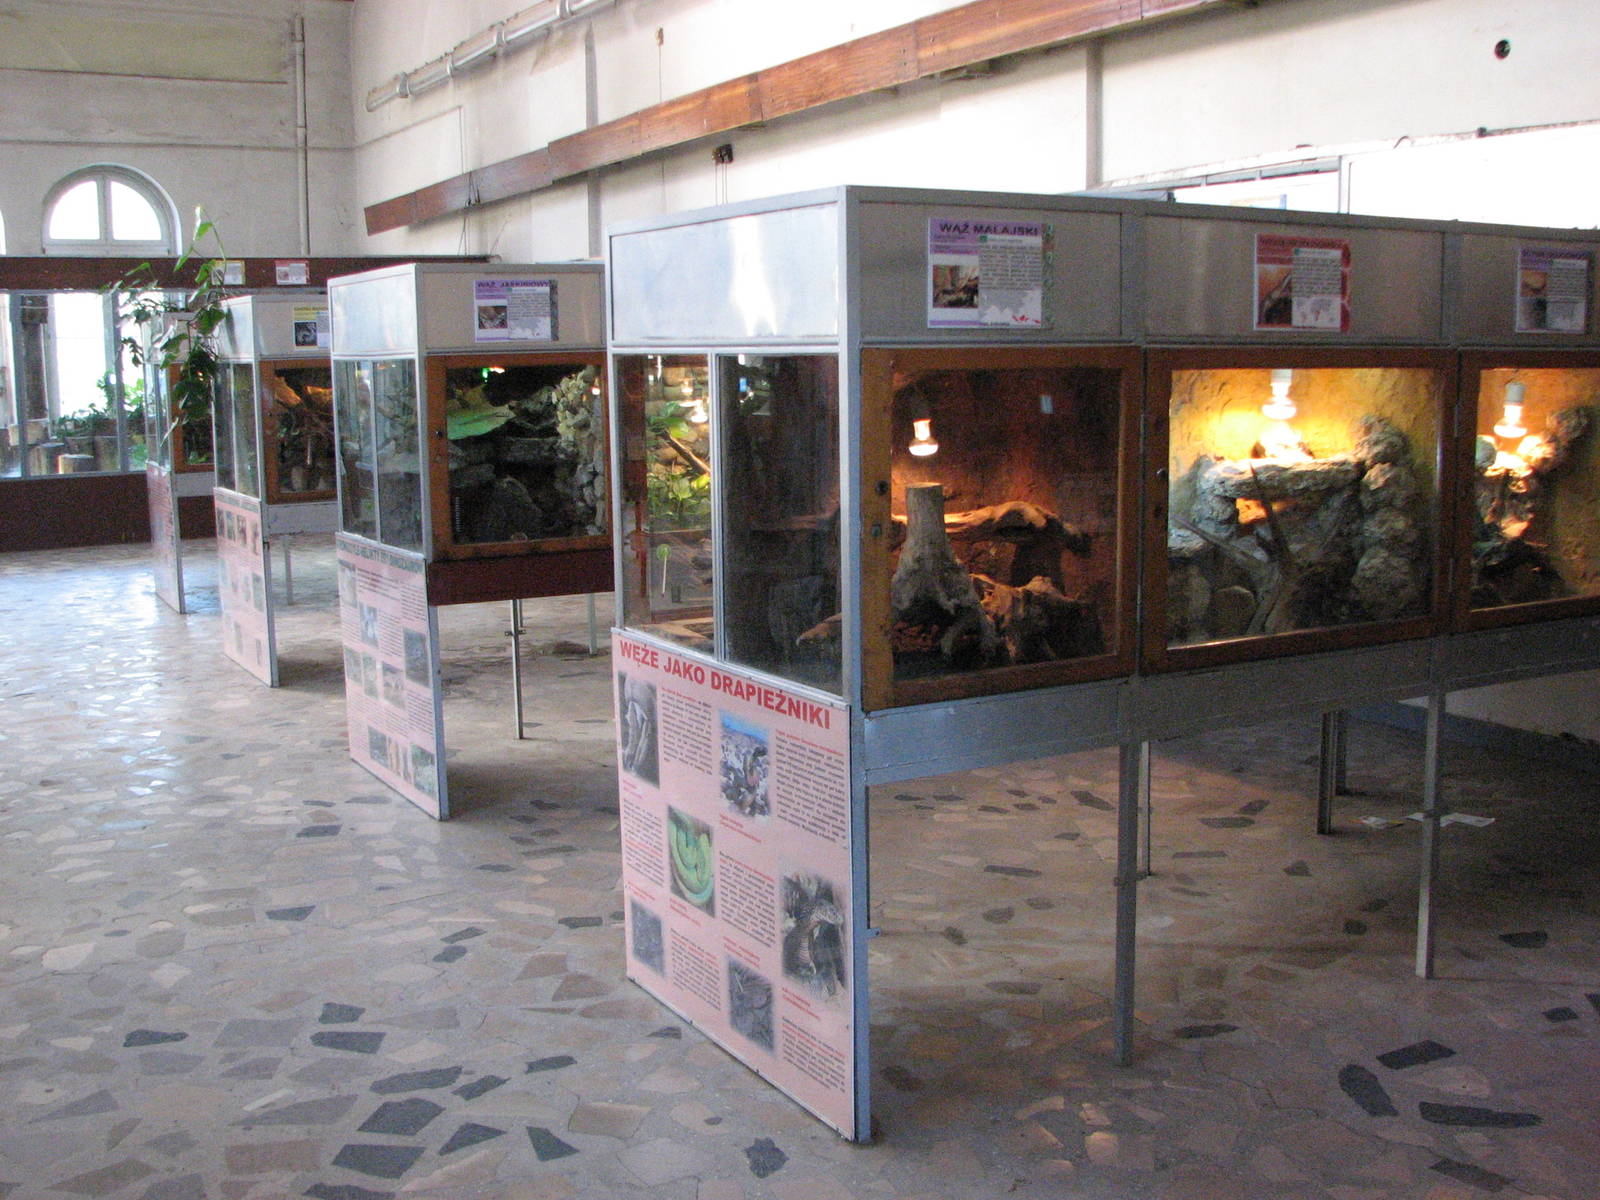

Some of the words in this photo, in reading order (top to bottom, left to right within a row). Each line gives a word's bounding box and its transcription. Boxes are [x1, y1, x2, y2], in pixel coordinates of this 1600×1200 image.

[939, 223, 970, 235] WĄŻ
[973, 224, 1038, 236] MALAJSKI
[620, 640, 659, 669] WĘŻE
[664, 656, 705, 685] JAKO
[711, 671, 831, 730] DRAPIEŻNIKI
